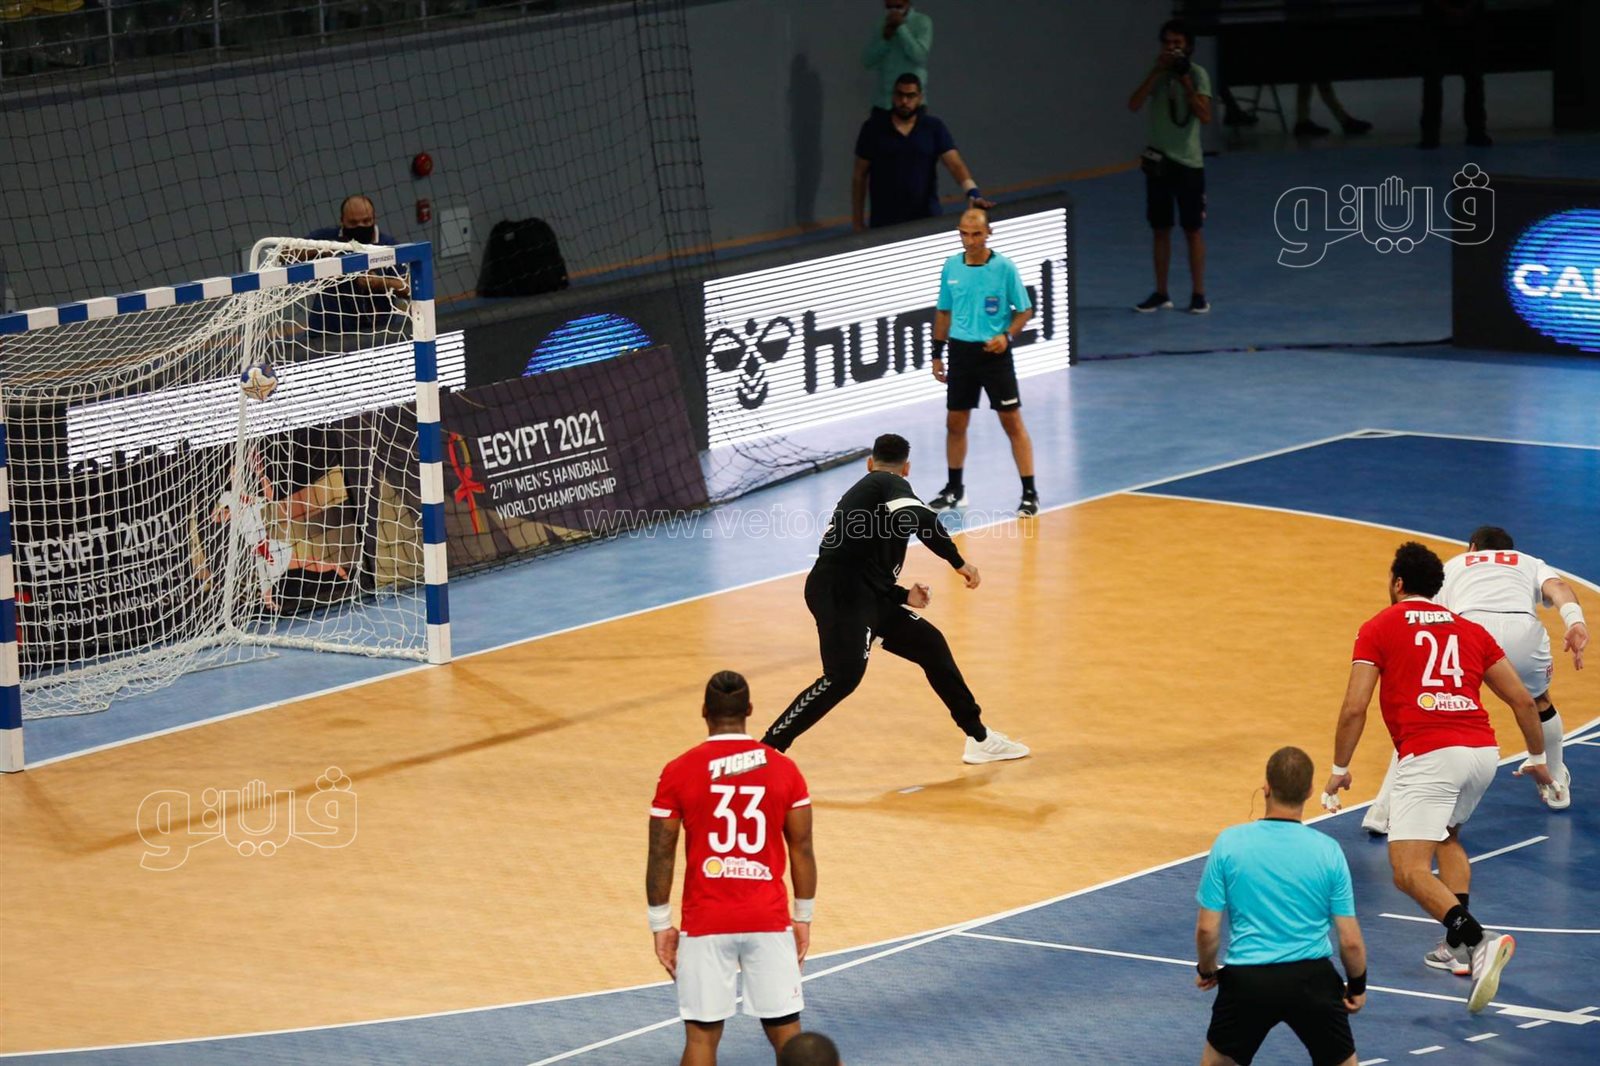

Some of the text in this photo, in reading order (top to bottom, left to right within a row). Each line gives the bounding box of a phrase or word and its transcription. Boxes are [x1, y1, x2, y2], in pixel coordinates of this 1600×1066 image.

[477, 410, 606, 470] EGYPT 2021
[490, 456, 610, 500] 27TH MEN'S HANDBALL
[496, 477, 617, 520] WORLD CHAMPIONSHIP
[24, 526, 110, 578] EGYPT
[1405, 610, 1454, 625] TIGER
[1414, 630, 1465, 688] 24
[1438, 700, 1474, 709] HELIX
[708, 748, 768, 780] TIGER
[708, 784, 766, 854] 33
[726, 866, 769, 878] HELIX
